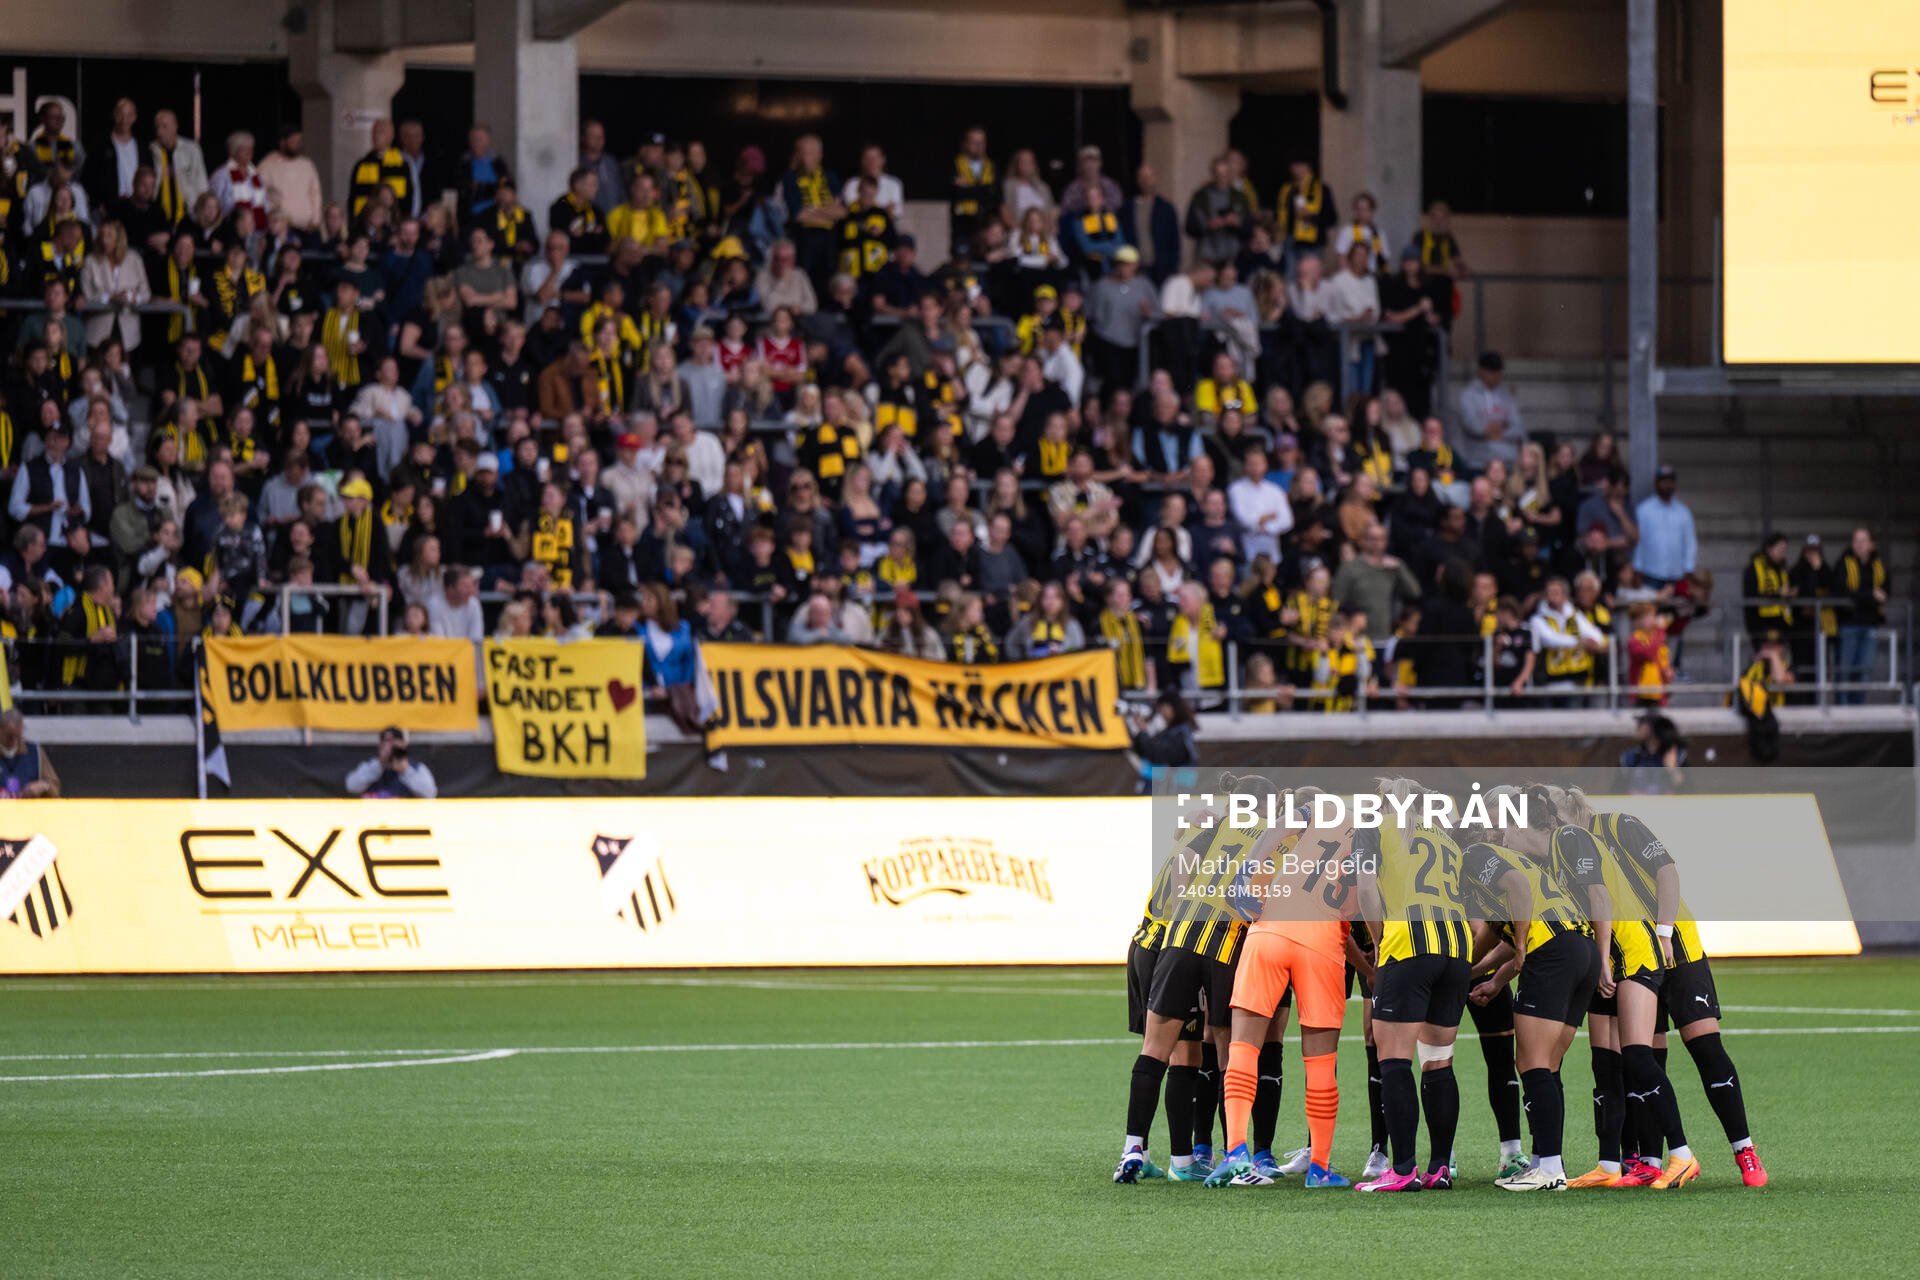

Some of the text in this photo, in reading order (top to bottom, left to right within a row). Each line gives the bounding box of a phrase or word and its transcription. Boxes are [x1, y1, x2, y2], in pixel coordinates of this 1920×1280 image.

[226, 661, 457, 703] BOLLKLUBBEN
[490, 649, 574, 680] FAST-
[493, 682, 601, 712] LANDET
[929, 671, 1105, 735] HÄCKEN
[523, 721, 611, 765] BKH
[180, 829, 450, 899] EXE
[863, 848, 1055, 904] KOPPARBERG
[1409, 836, 1464, 904] 25
[252, 911, 422, 950] MÅLERI
